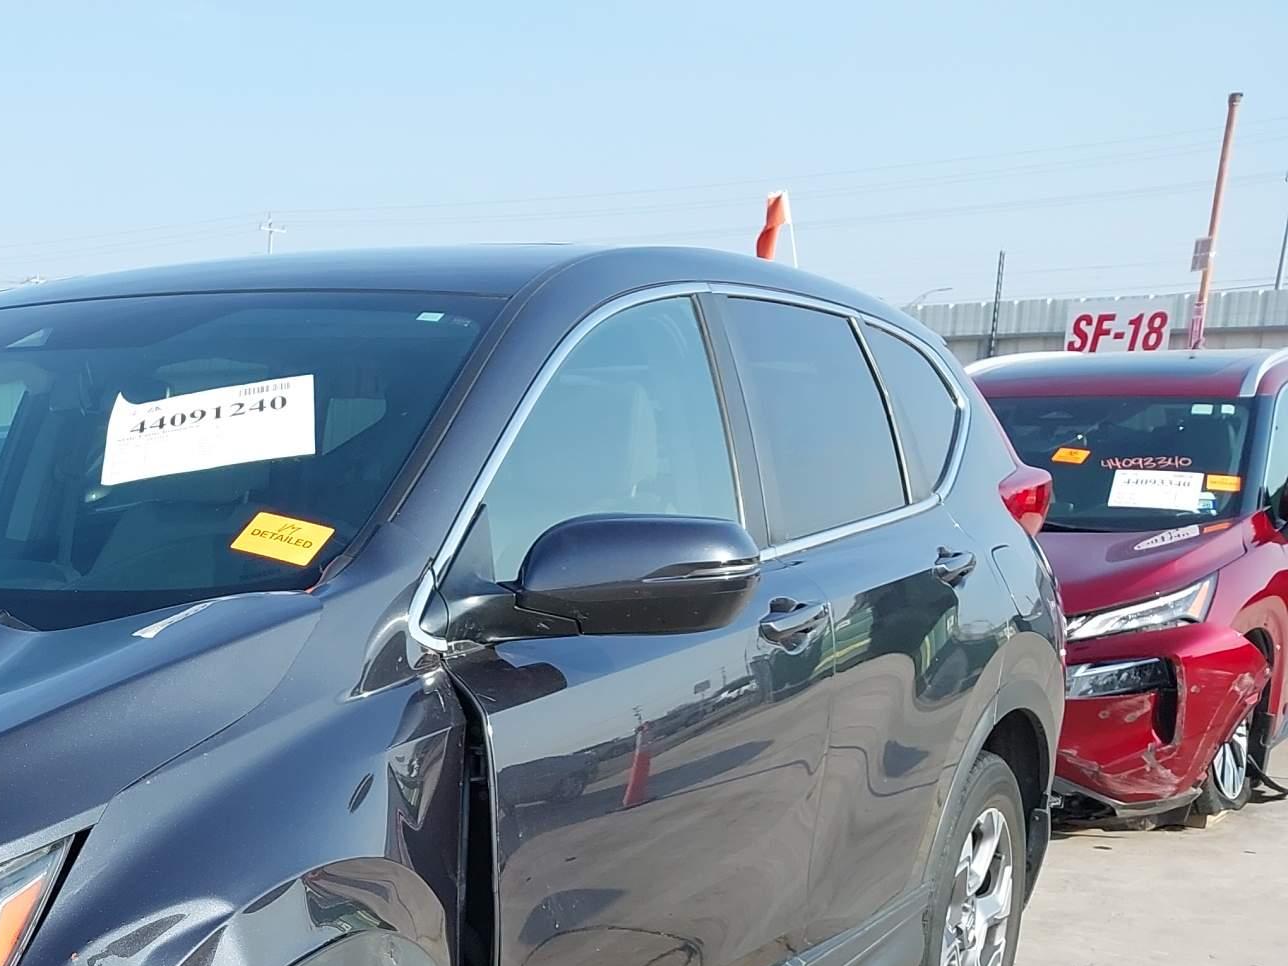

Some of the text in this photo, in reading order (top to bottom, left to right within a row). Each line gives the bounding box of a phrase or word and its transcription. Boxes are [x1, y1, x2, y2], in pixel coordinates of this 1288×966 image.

[1067, 310, 1169, 353] SF-18
[129, 395, 287, 434] 44091240
[1101, 456, 1193, 470] 44093340
[250, 528, 313, 550] DETAILED
